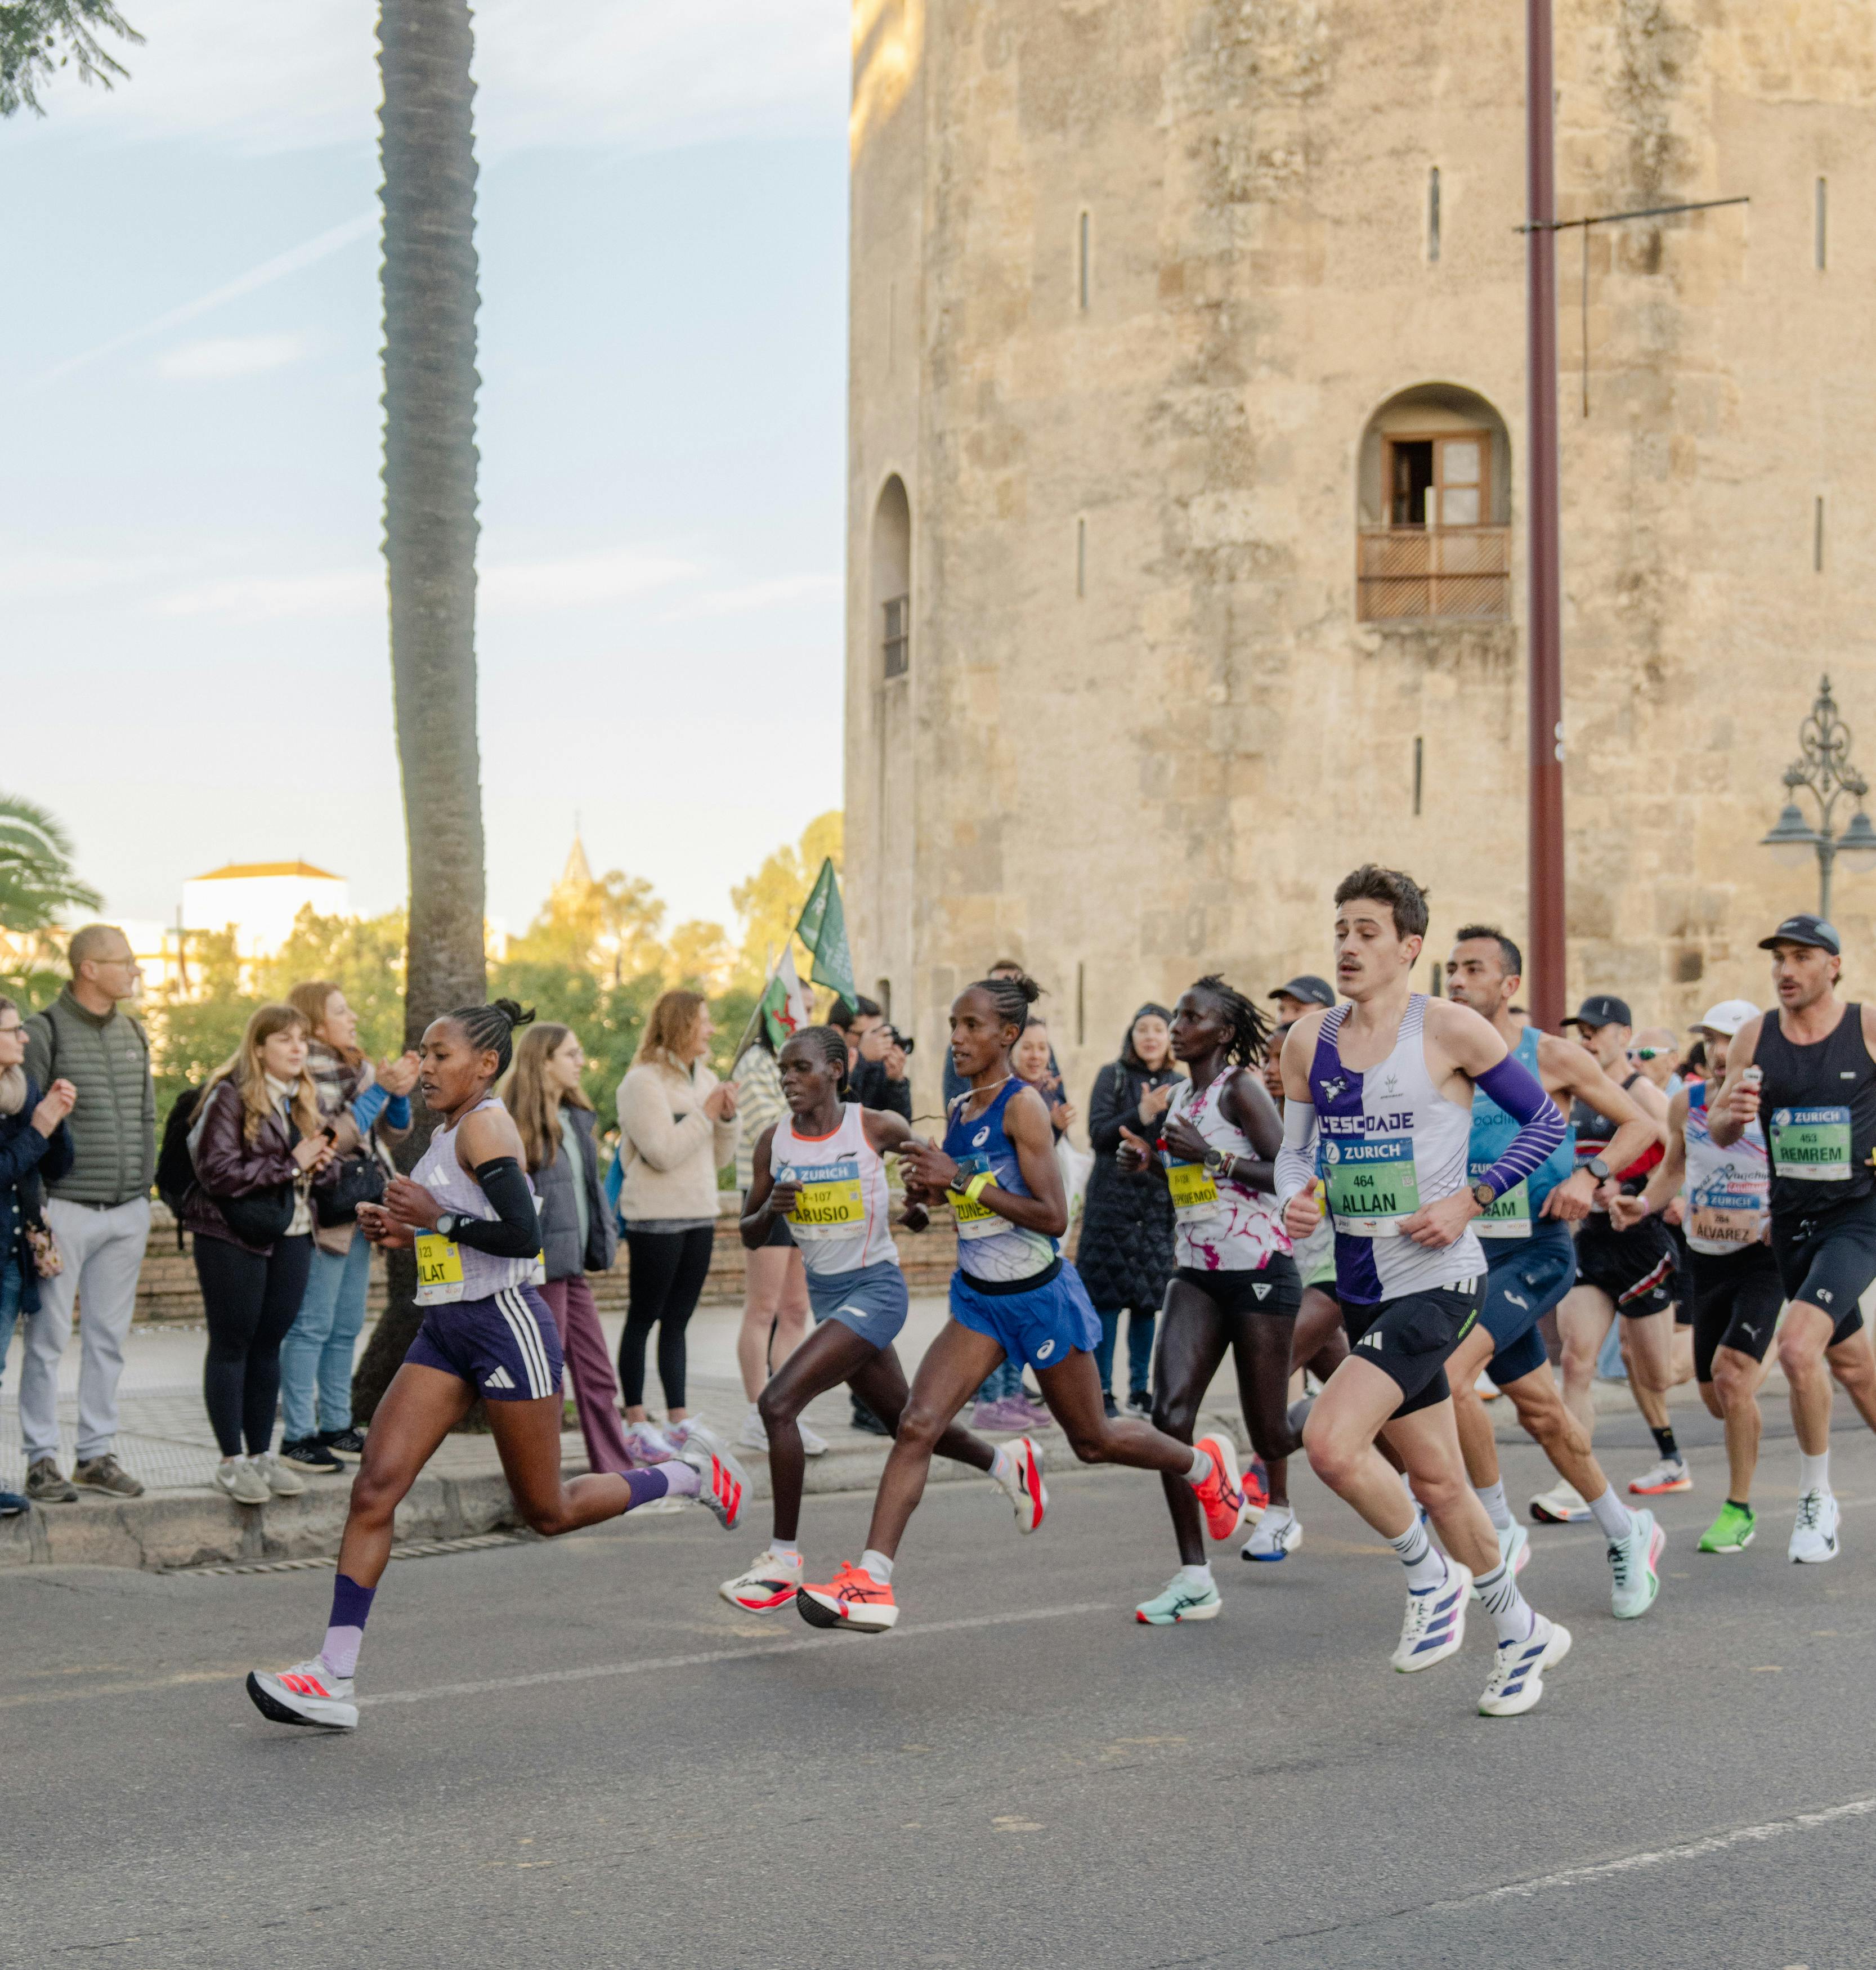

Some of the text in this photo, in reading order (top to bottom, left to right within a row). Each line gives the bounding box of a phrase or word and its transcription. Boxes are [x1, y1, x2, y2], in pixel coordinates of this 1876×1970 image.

[1794, 1111, 1841, 1123] ZURICH
[1344, 1143, 1401, 1160] ZURICH
[1780, 1147, 1842, 1161] REMREM
[800, 1166, 849, 1181] ZURICH
[1353, 1175, 1374, 1187] 464
[803, 1190, 831, 1203] F-107
[1342, 1193, 1396, 1212] ALLAN
[1710, 1194, 1751, 1207] ZURICH
[795, 1206, 849, 1222] ARUSIO
